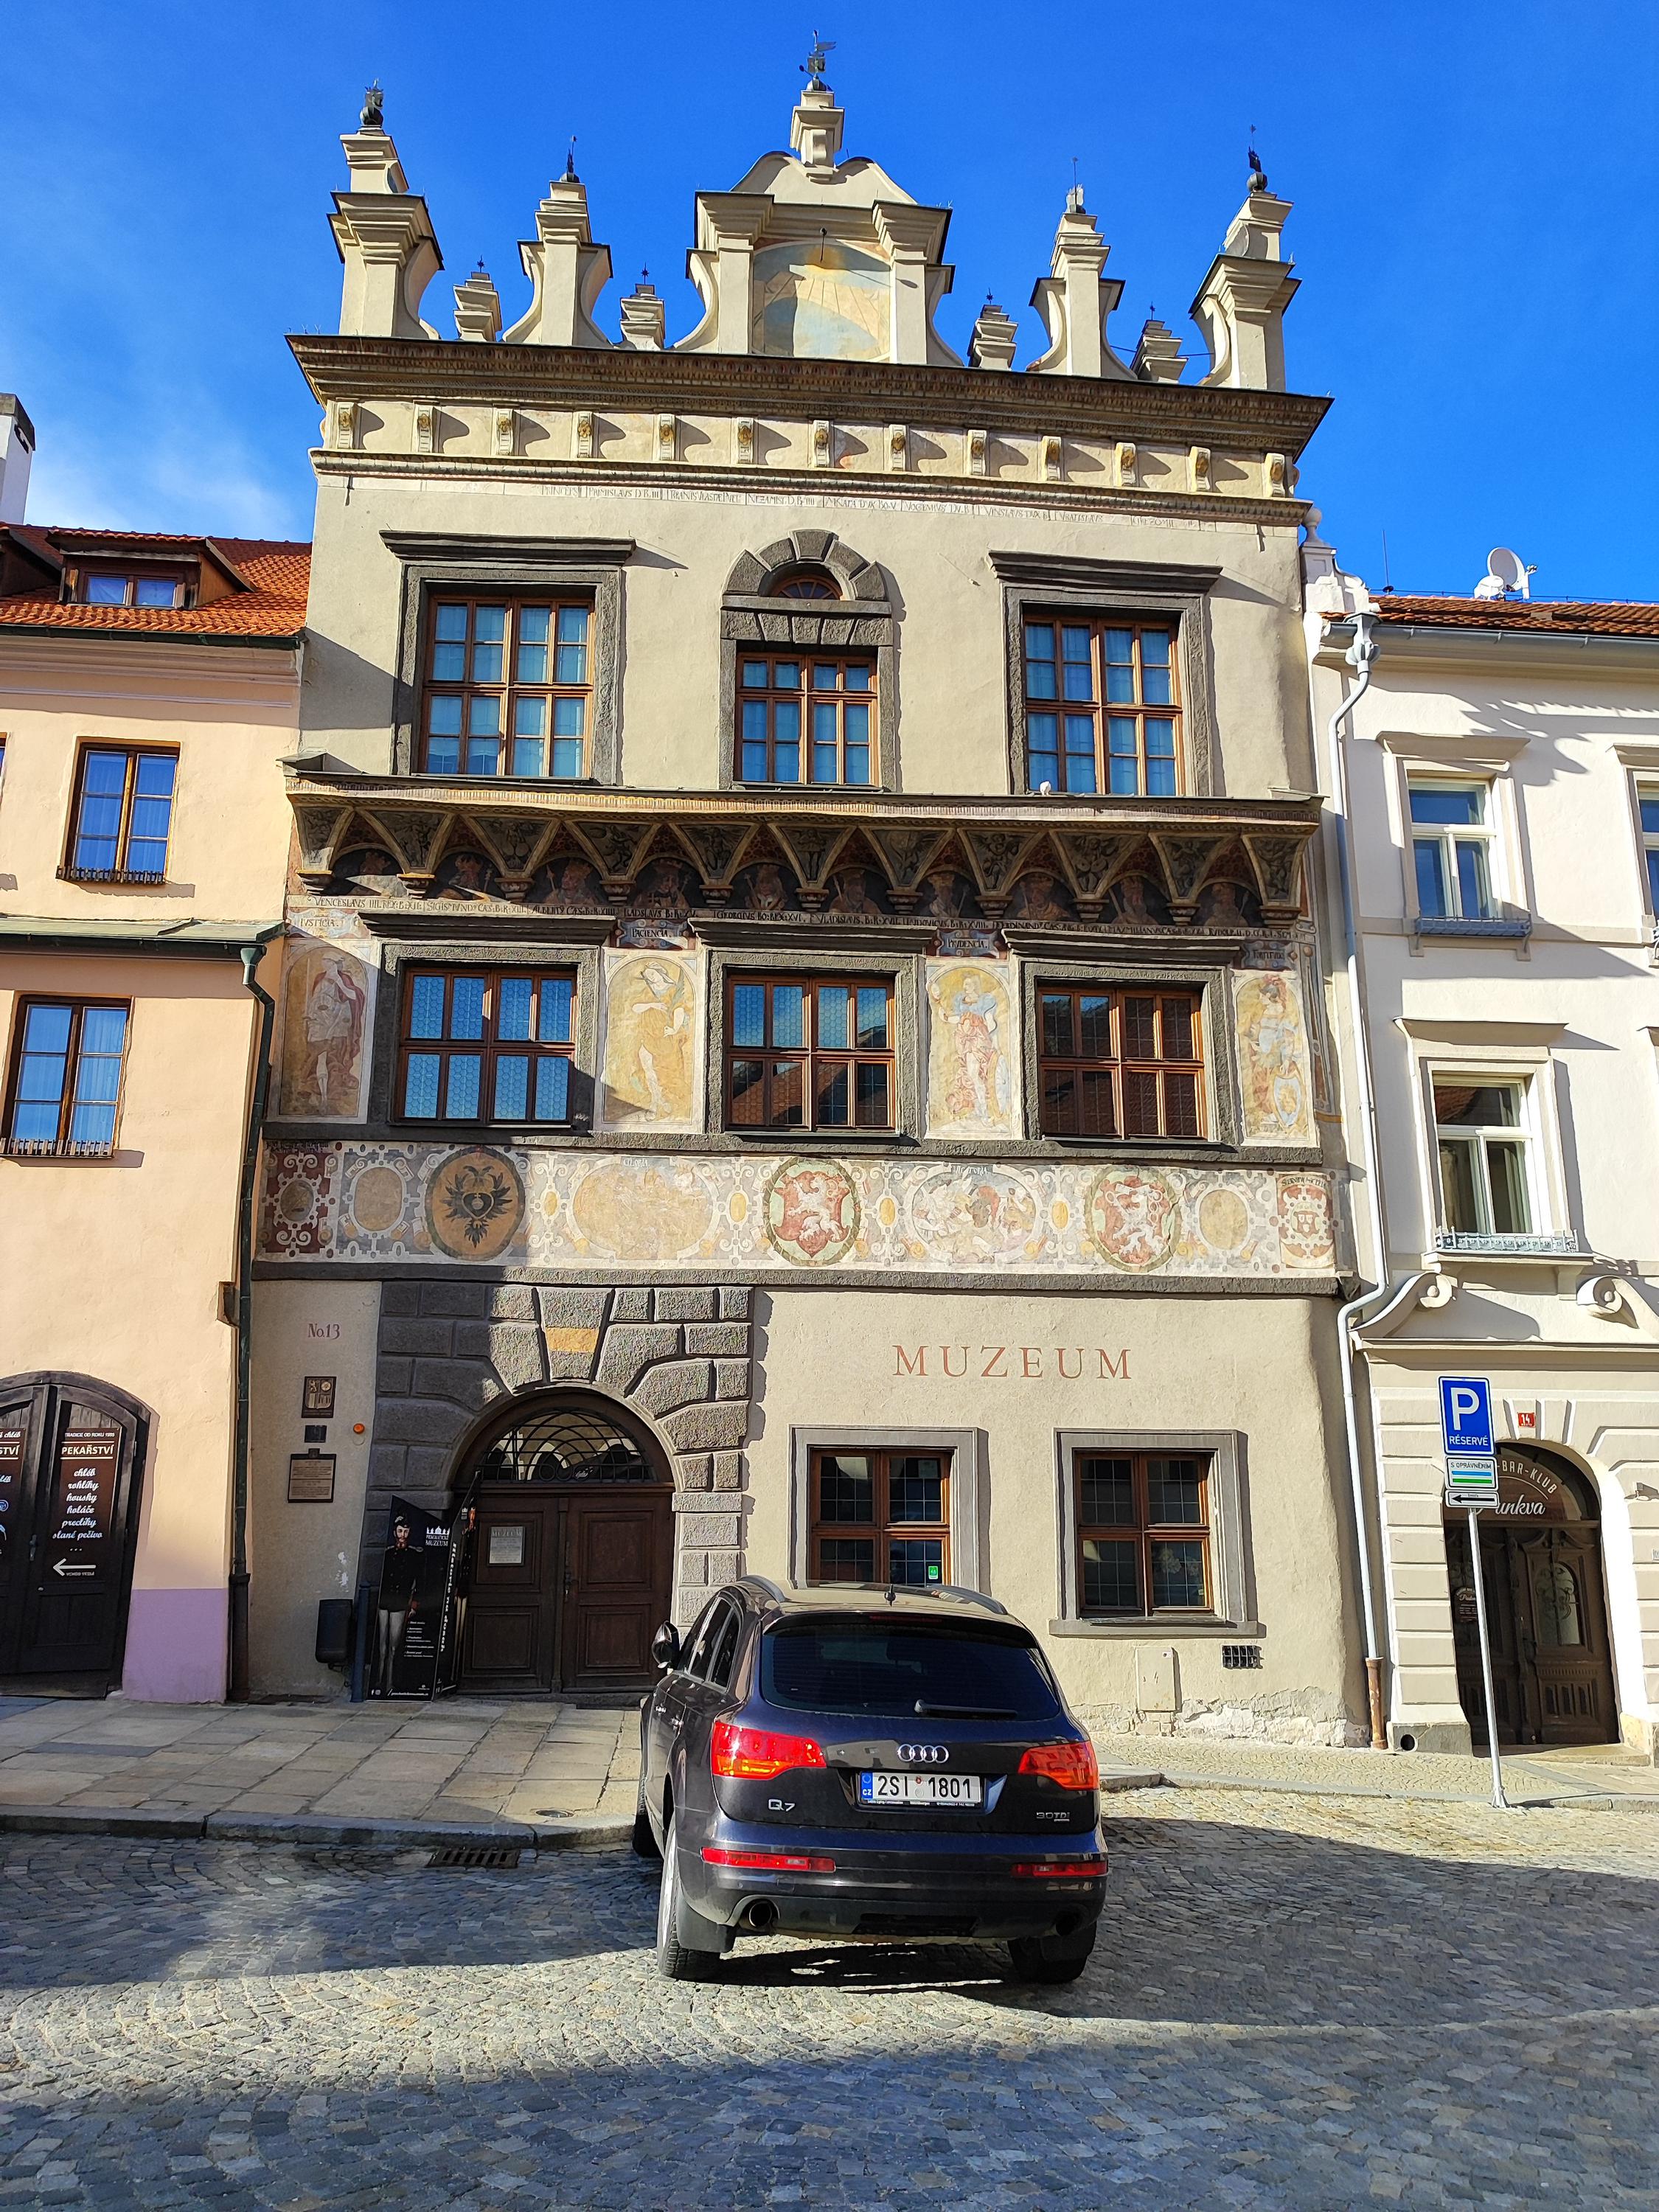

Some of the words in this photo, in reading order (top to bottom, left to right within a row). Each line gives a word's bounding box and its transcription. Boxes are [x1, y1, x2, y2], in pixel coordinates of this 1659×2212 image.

[892, 1345, 1132, 1380] MUZEUM
[1450, 1387, 1480, 1431] P
[1520, 1413, 1530, 1424] 14
[1449, 1434, 1489, 1446] RÉSERVÉ
[61, 1444, 114, 1455] PEKAŘSTVÍ
[74, 1467, 96, 1477] chléb
[68, 1480, 100, 1491] rohlíky
[66, 1492, 98, 1503] housky
[66, 1506, 95, 1514] koláče
[1484, 1494, 1545, 1515] unkva
[52, 1529, 77, 1539] slané
[877, 1775, 909, 1797] 2SI
[928, 1777, 971, 1799] 1801
[768, 1798, 796, 1812] Q7
